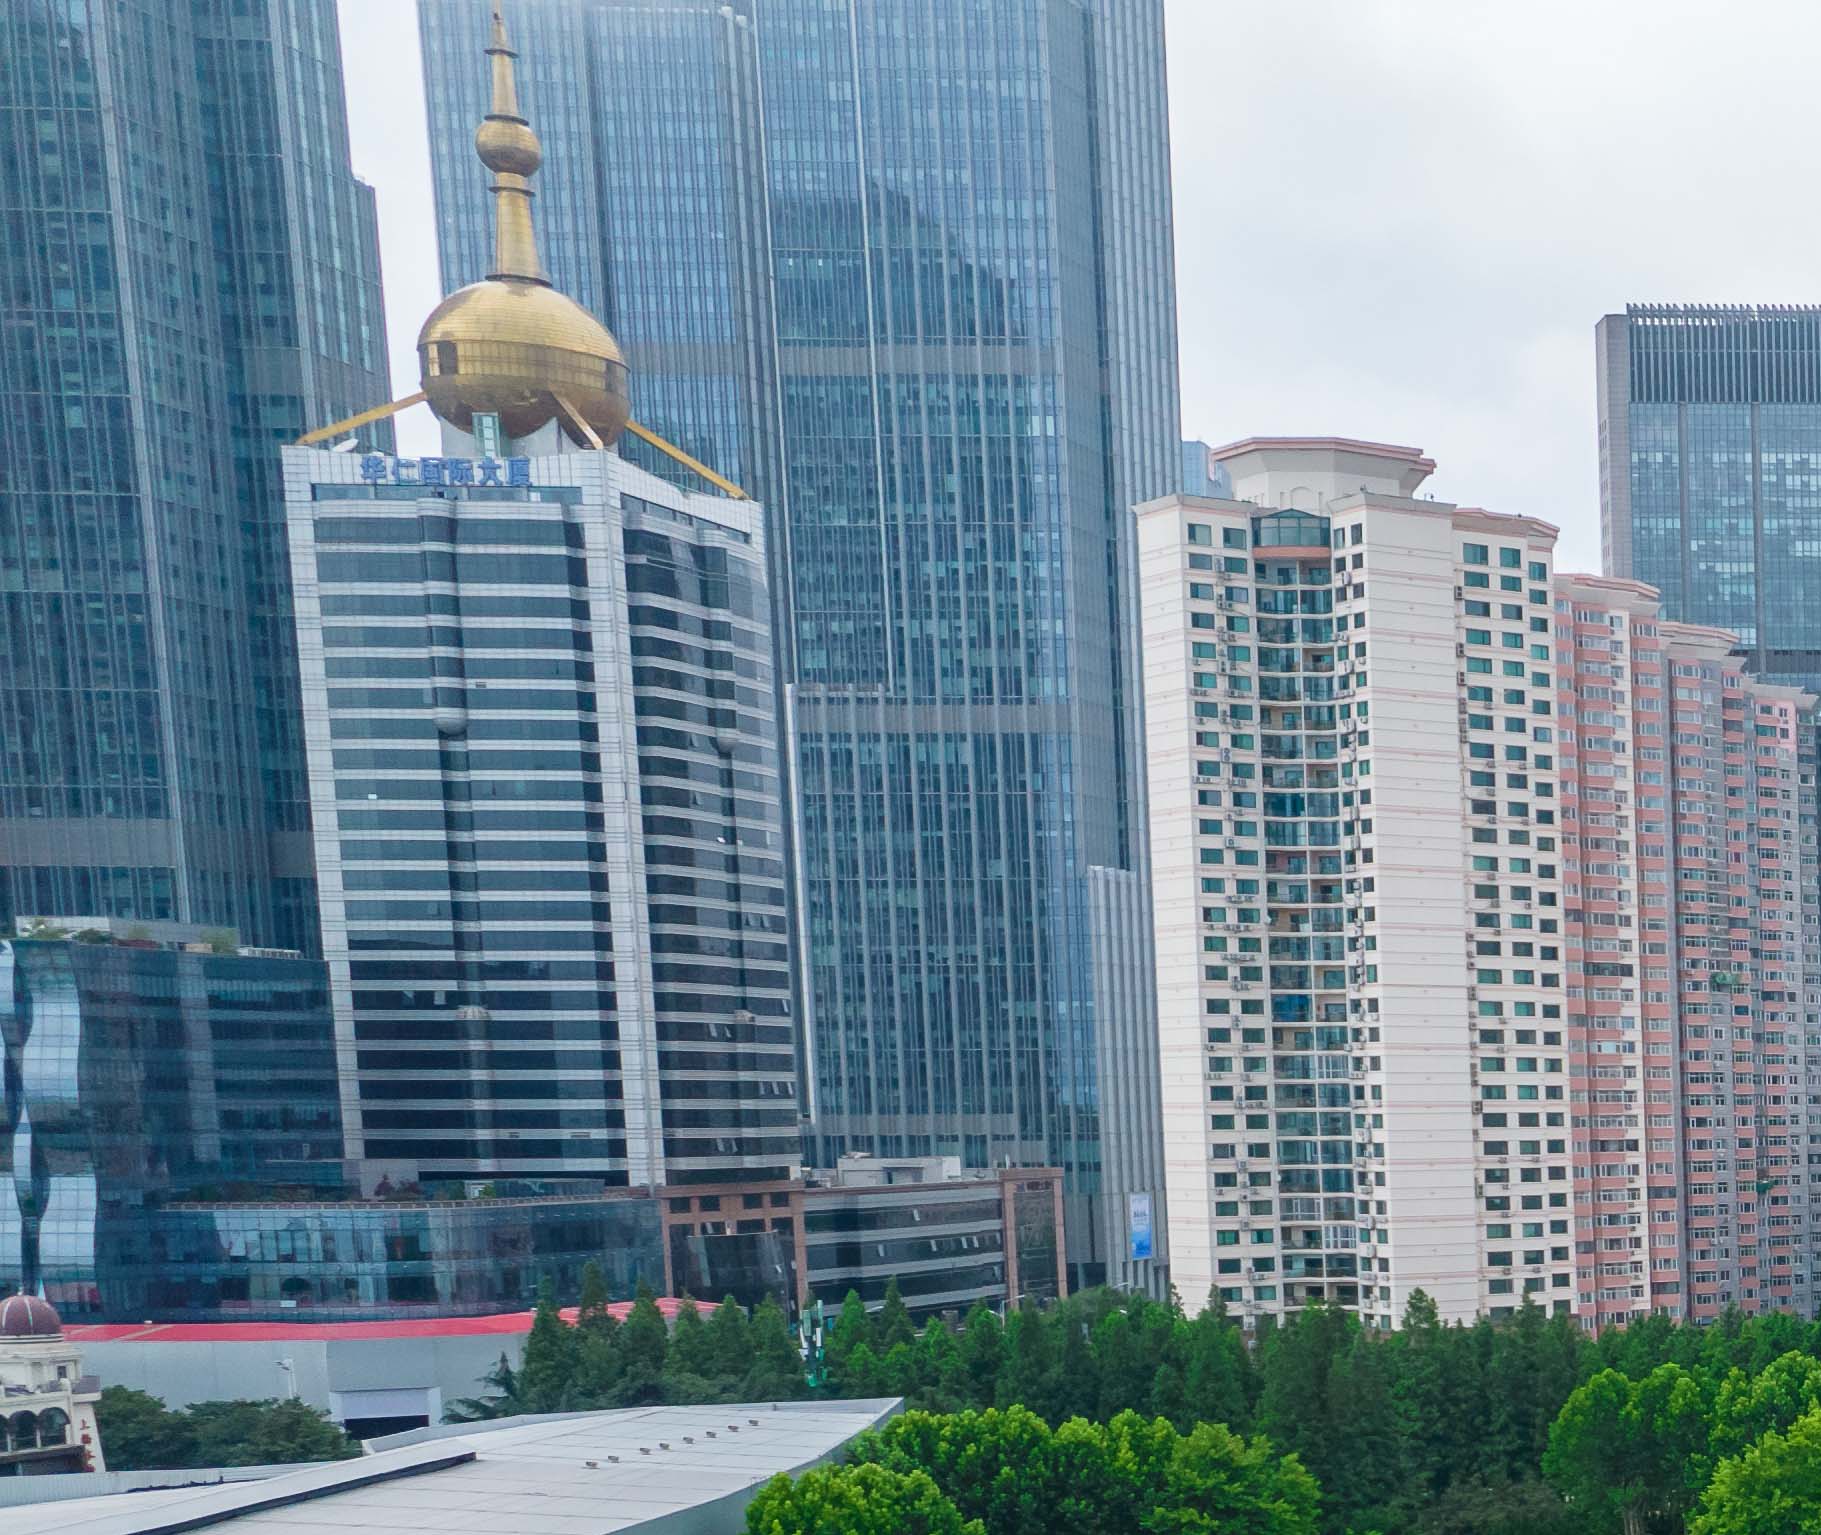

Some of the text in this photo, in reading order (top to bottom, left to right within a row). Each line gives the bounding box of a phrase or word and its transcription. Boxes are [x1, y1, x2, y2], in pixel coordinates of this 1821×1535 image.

[361, 457, 532, 487] 华仁国际大厦
